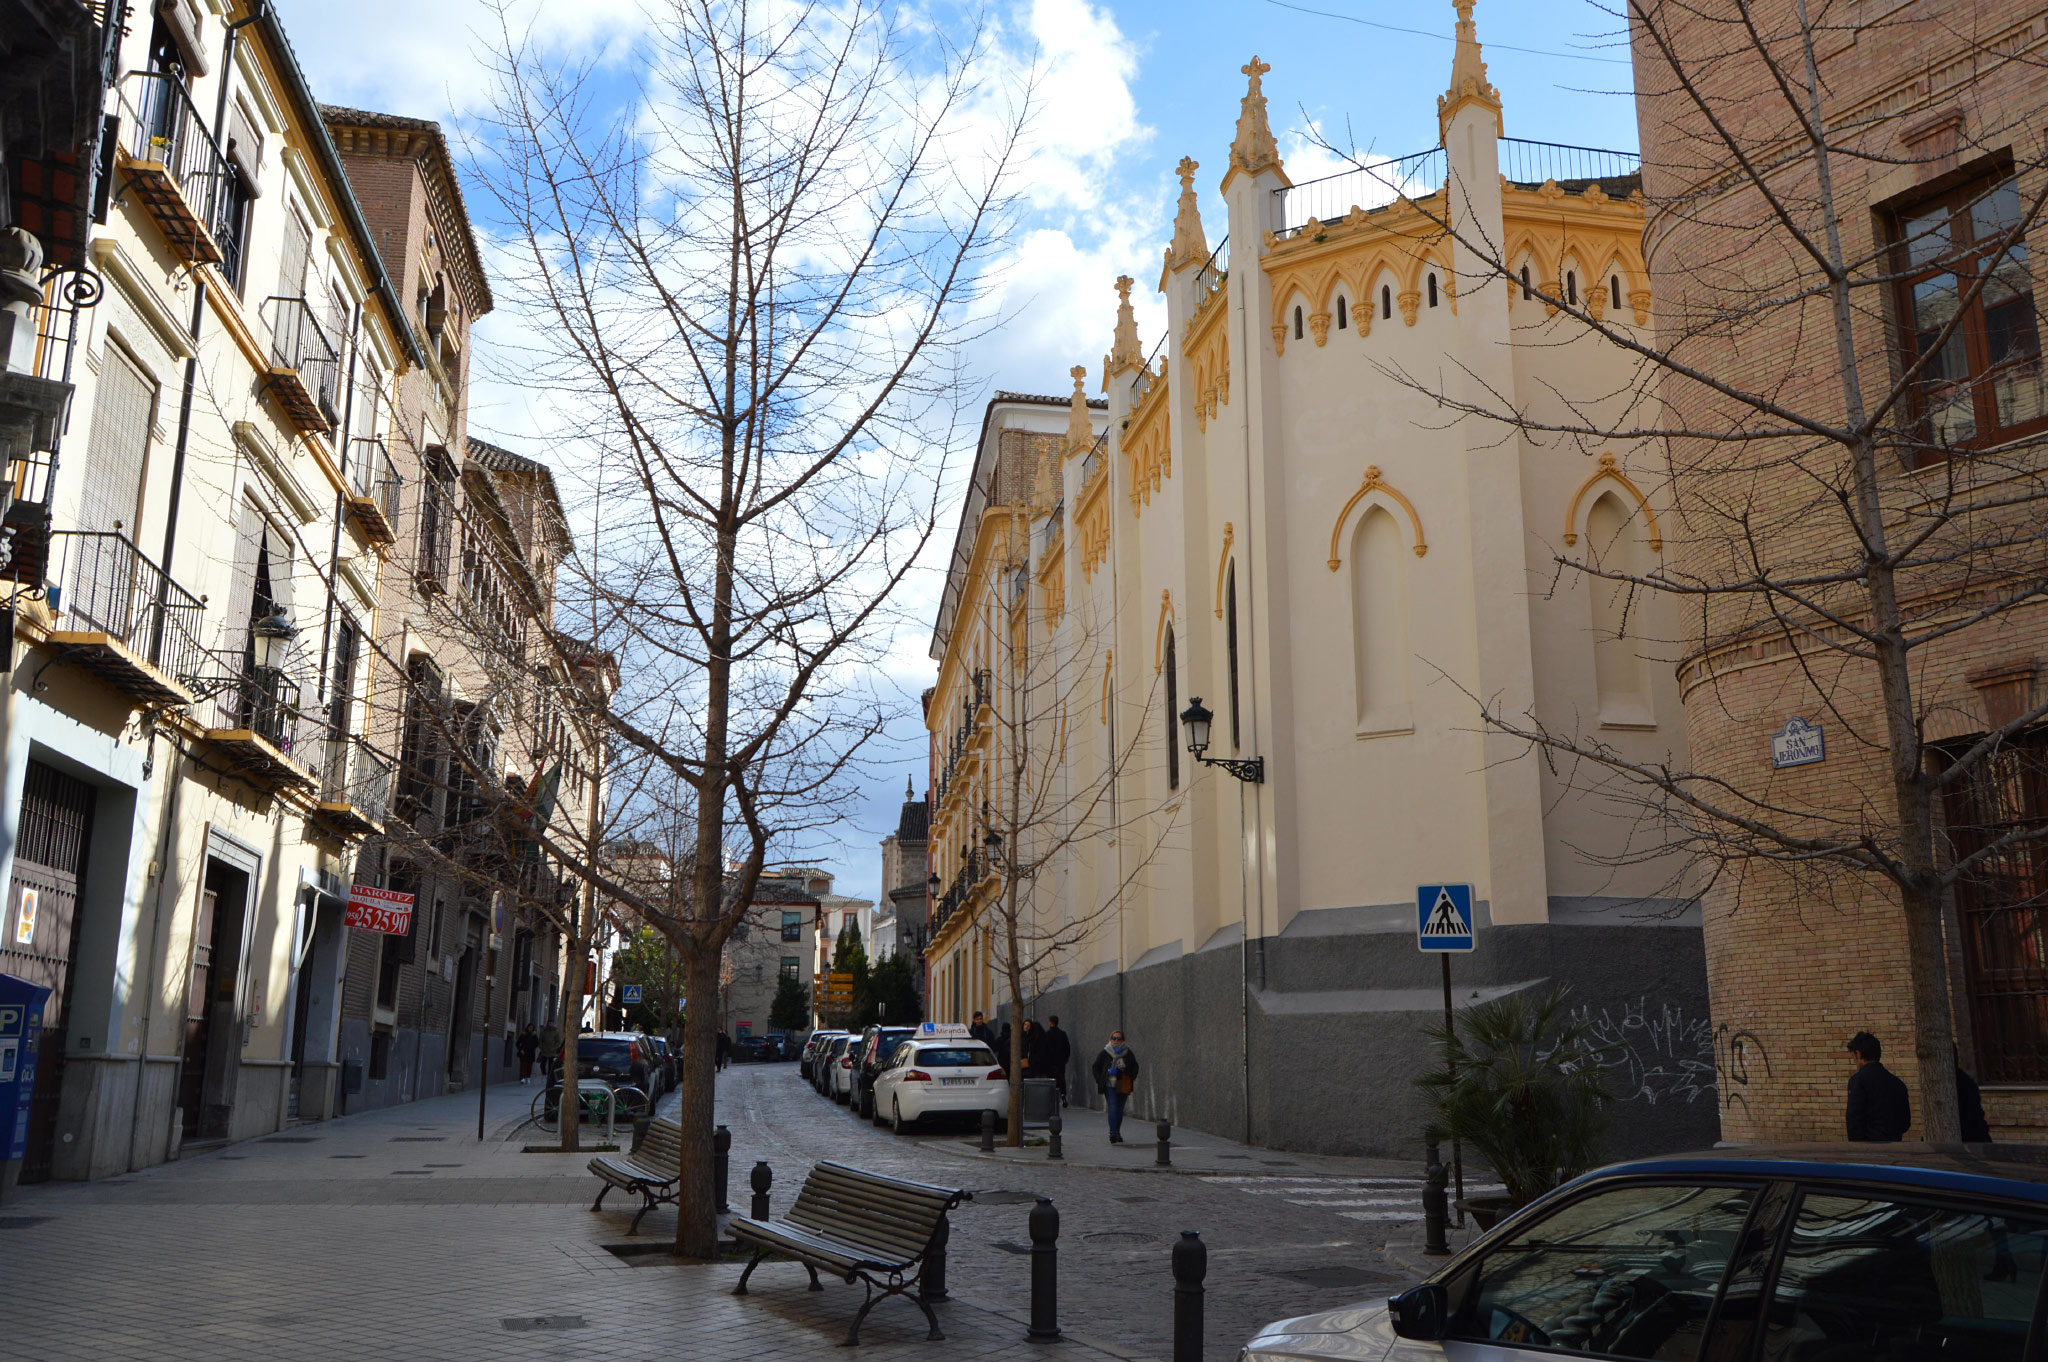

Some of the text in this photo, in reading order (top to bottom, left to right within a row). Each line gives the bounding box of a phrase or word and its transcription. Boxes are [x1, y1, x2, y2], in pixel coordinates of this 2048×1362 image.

[1786, 736, 1806, 750] SAN
[351, 895, 381, 906] ALQUILA
[352, 886, 412, 903] MARQUEZ
[0, 1009, 19, 1032] P
[936, 1027, 966, 1035] Miranda
